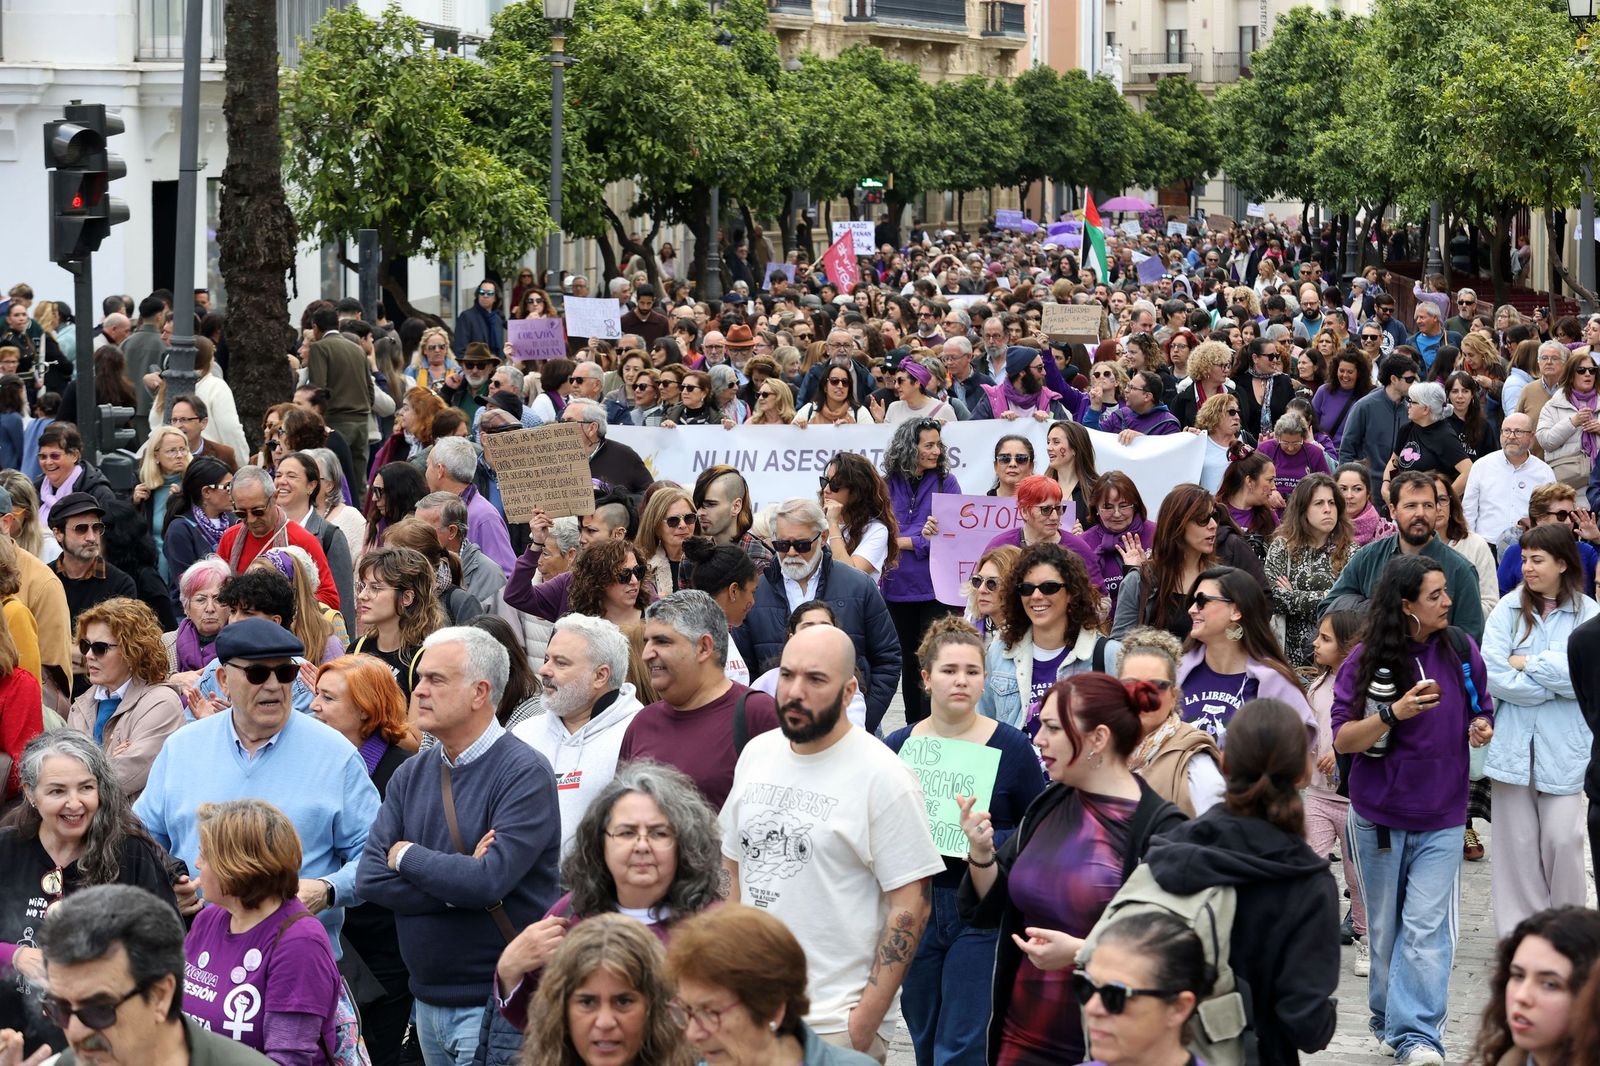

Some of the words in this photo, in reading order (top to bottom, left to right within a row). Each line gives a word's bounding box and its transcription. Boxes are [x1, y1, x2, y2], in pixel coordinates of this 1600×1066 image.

[1184, 693, 1200, 706] LA
[1202, 691, 1243, 710] LIBERTA
[901, 737, 942, 766] MIS
[743, 782, 840, 822] ANTIFASCIST
[26, 908, 38, 918] NO
